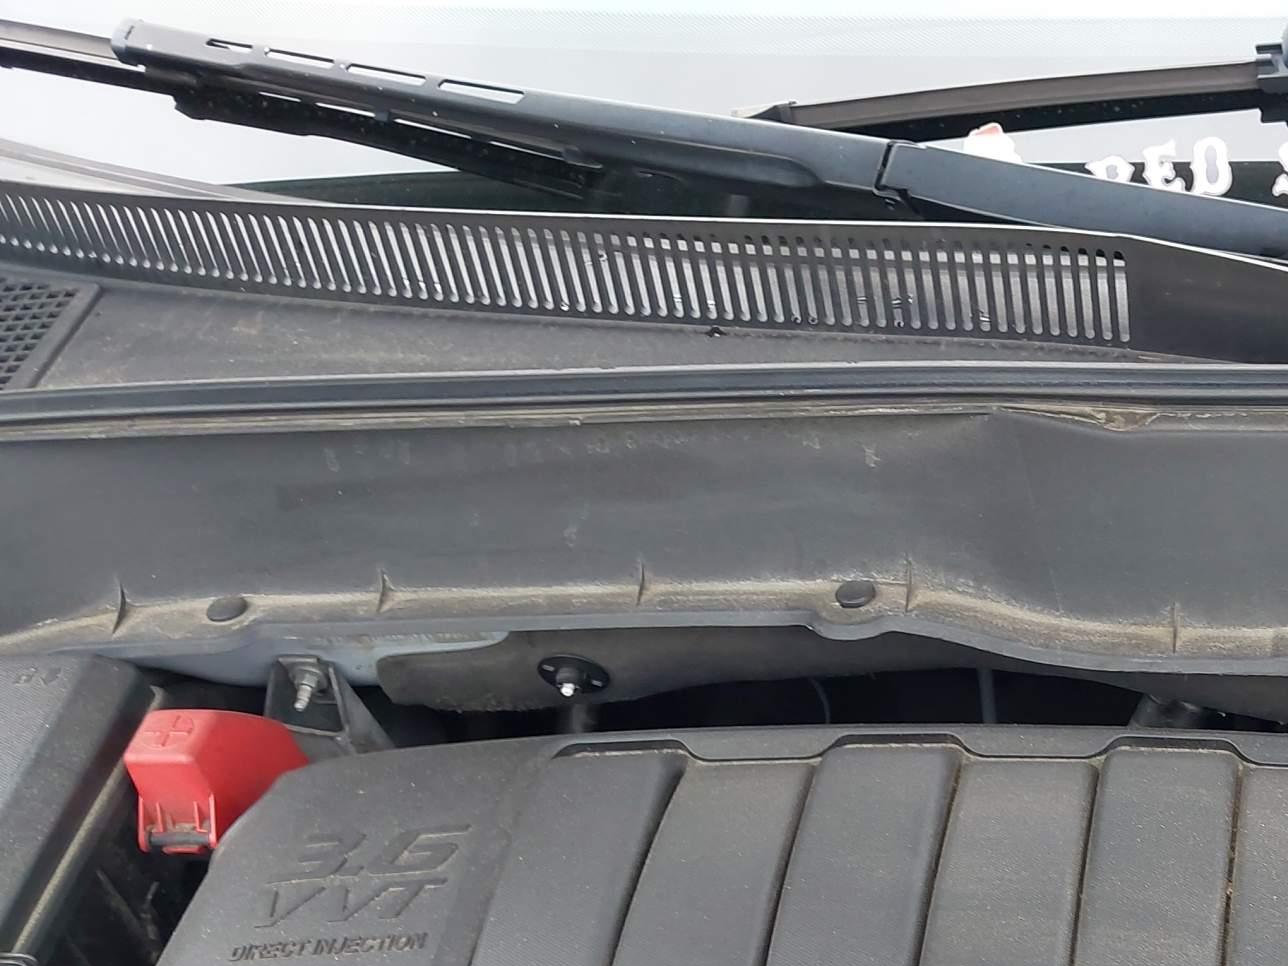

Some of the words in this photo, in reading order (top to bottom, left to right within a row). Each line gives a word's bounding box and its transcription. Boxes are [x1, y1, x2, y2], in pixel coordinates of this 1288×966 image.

[266, 823, 472, 885] 3.6
[253, 876, 449, 929] VVT
[229, 939, 311, 962] DIRECT
[312, 932, 429, 956] INJECTION
